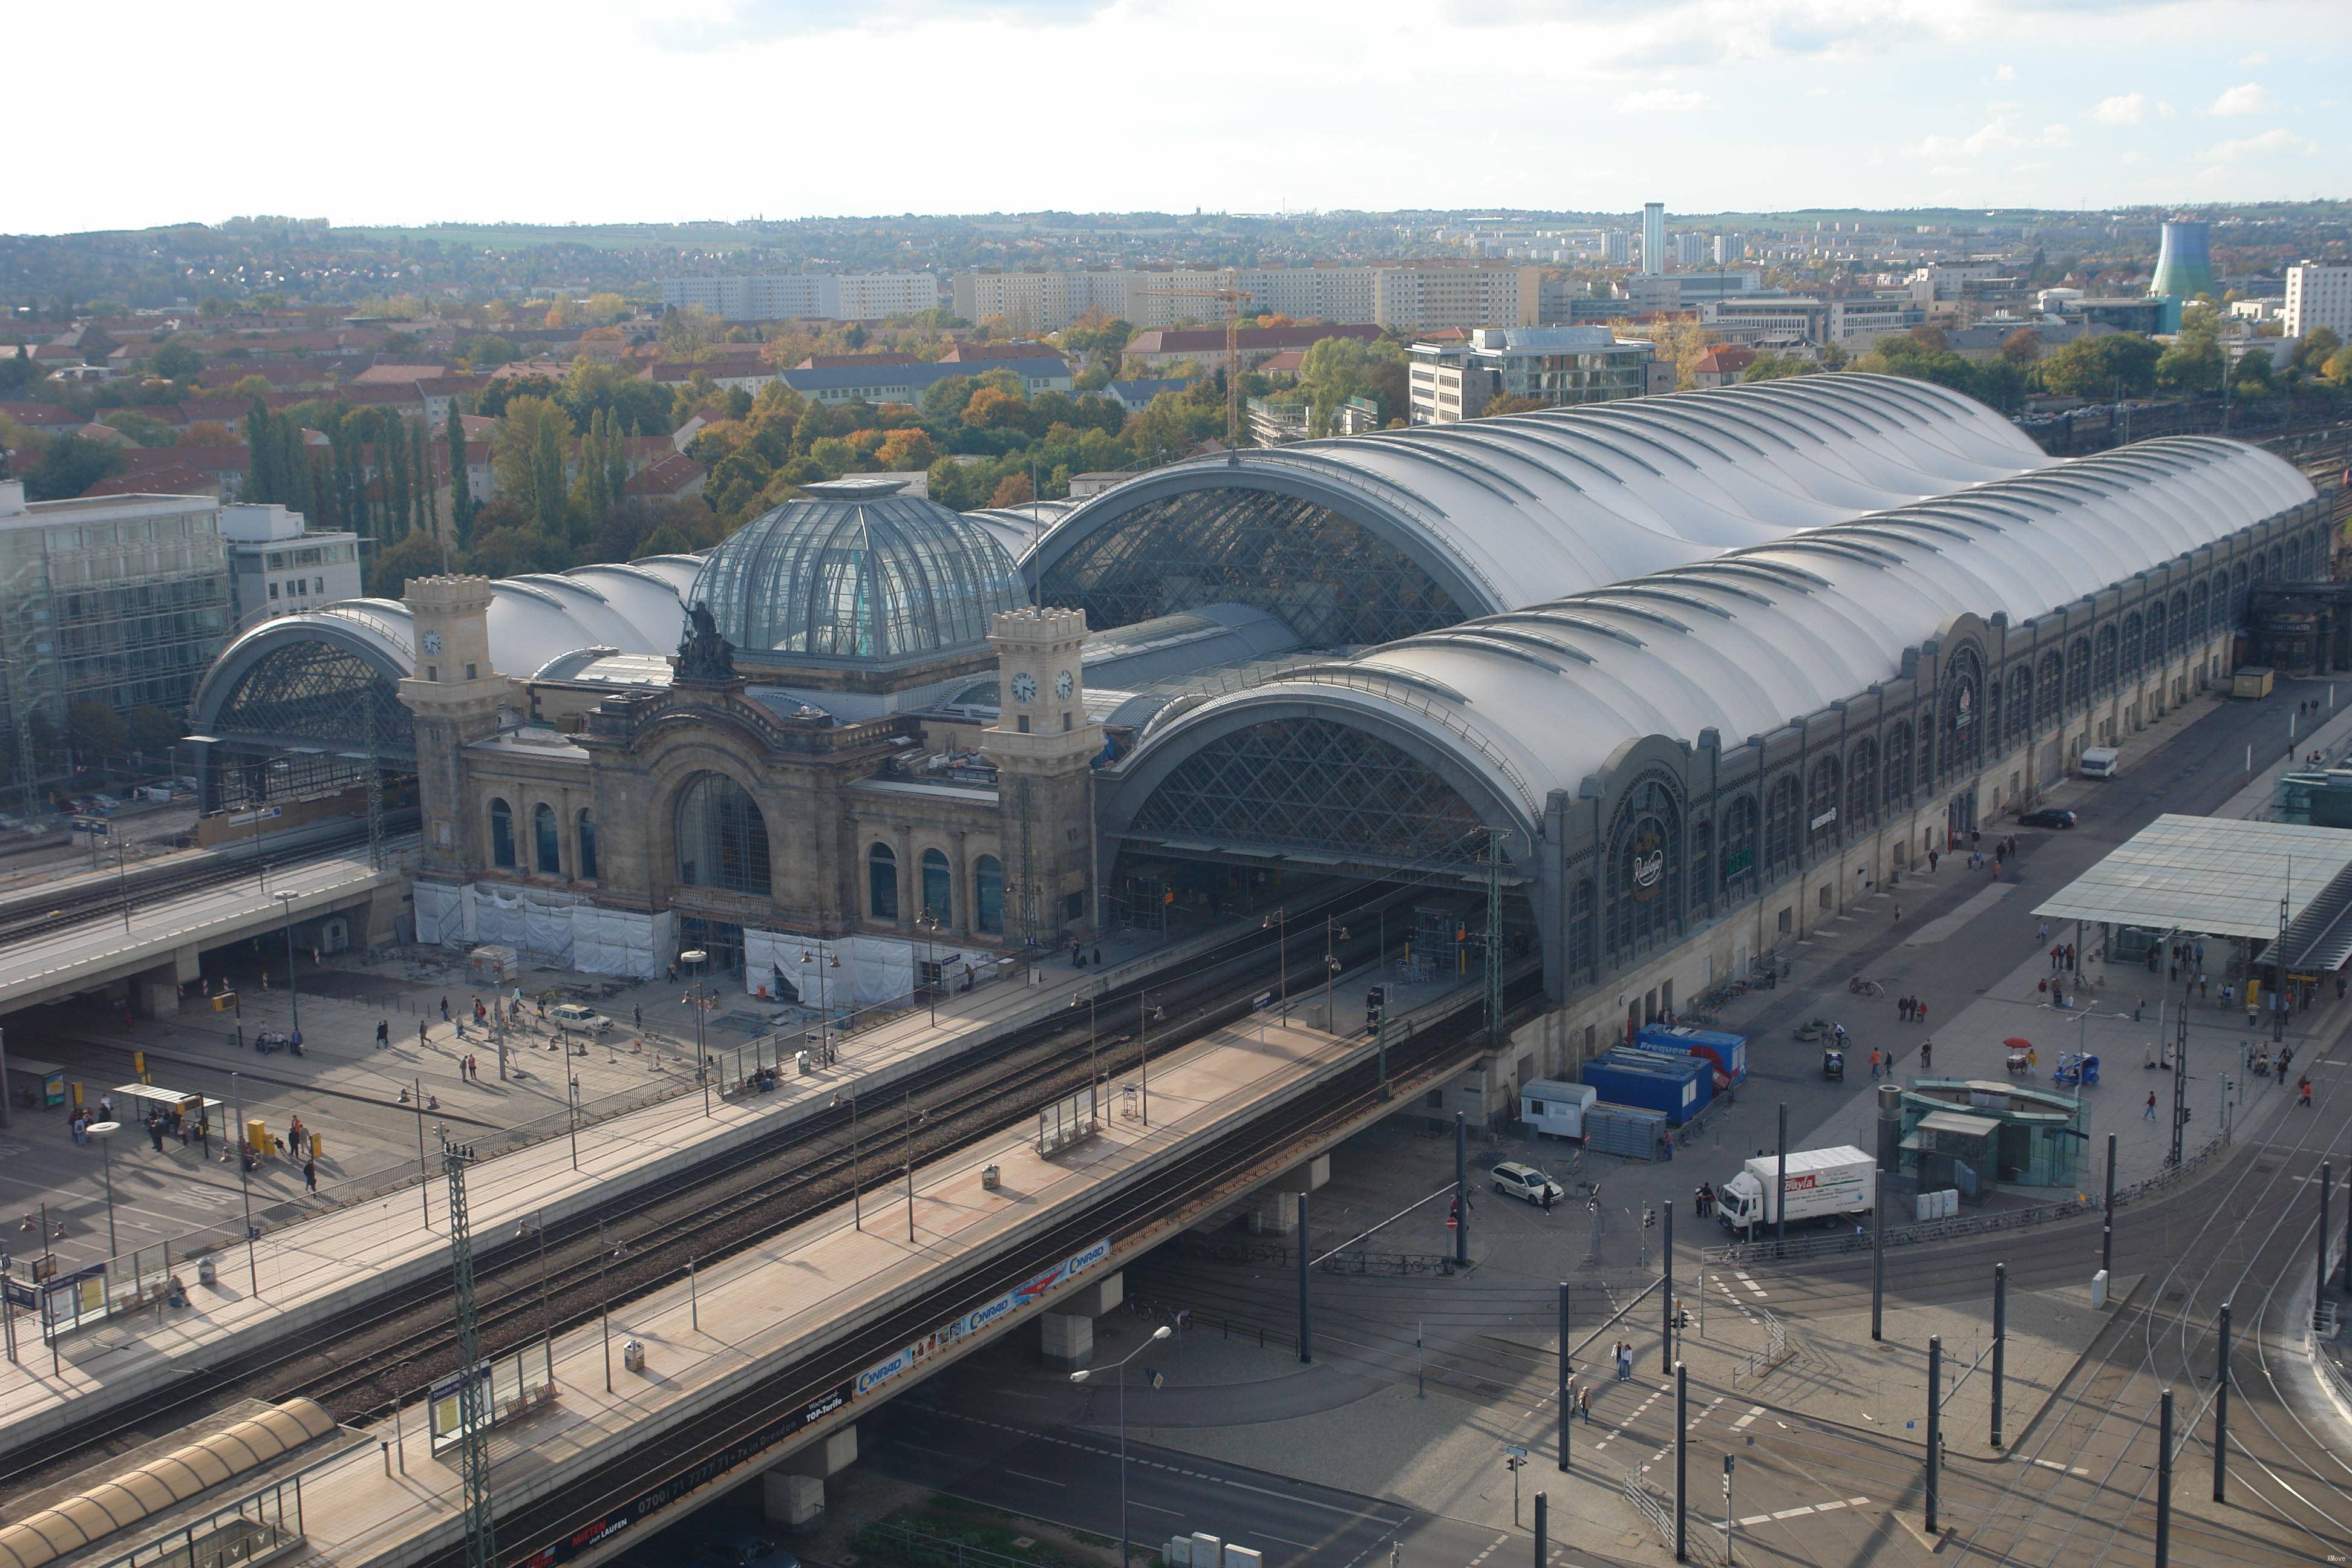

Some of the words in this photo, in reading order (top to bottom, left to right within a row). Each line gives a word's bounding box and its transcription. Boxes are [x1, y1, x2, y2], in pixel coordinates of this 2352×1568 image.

[1640, 1041, 1692, 1056] Frequenz
[1785, 1176, 1812, 1191] Bayla
[163, 1186, 240, 1210] BUS
[859, 1358, 901, 1393] CONRAD
[806, 1398, 842, 1422] TOP-Tarife
[760, 1422, 796, 1446] Dresden
[572, 1520, 607, 1547] MIETEN
[601, 1518, 627, 1538] LAUFEN
